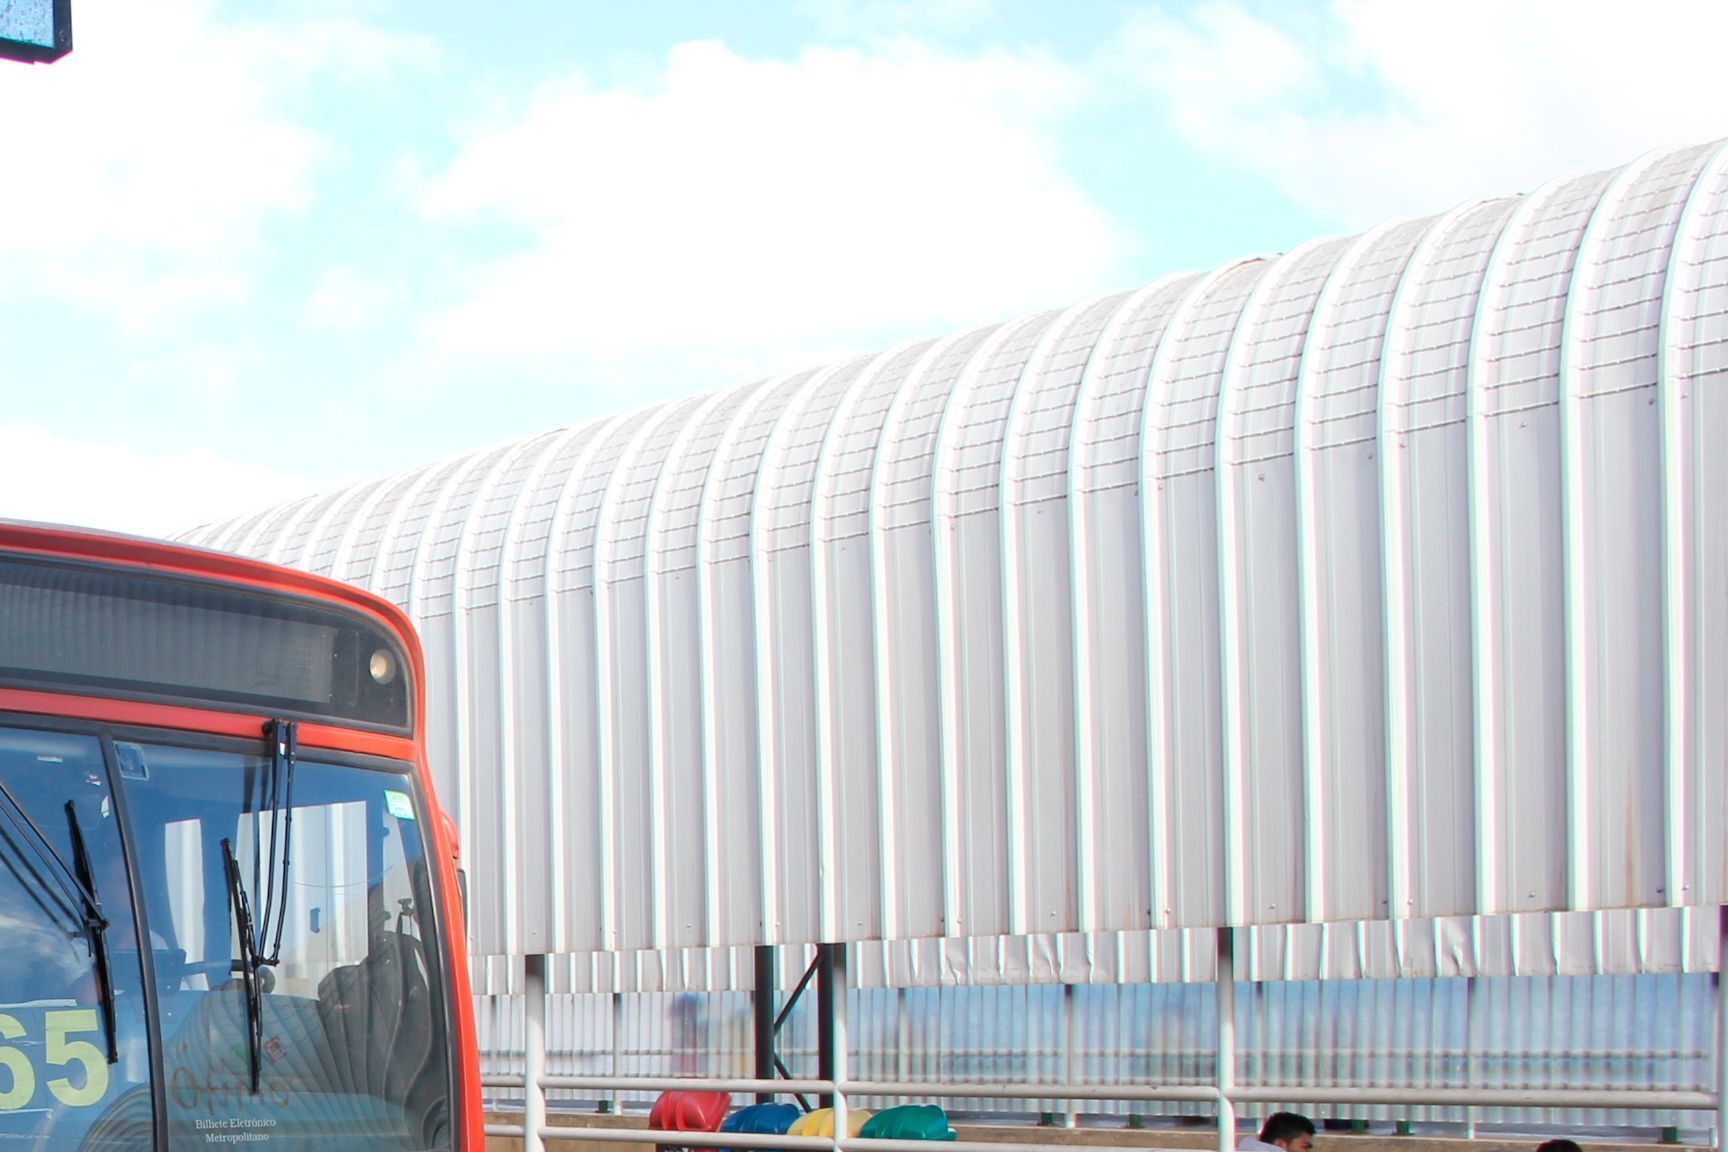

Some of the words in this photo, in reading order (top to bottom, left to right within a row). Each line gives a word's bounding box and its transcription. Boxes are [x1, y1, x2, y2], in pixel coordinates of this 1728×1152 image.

[195, 1118, 228, 1130] Bilhete
[230, 1117, 277, 1129] Eletrônico
[205, 1132, 270, 1144] Metropolitano
